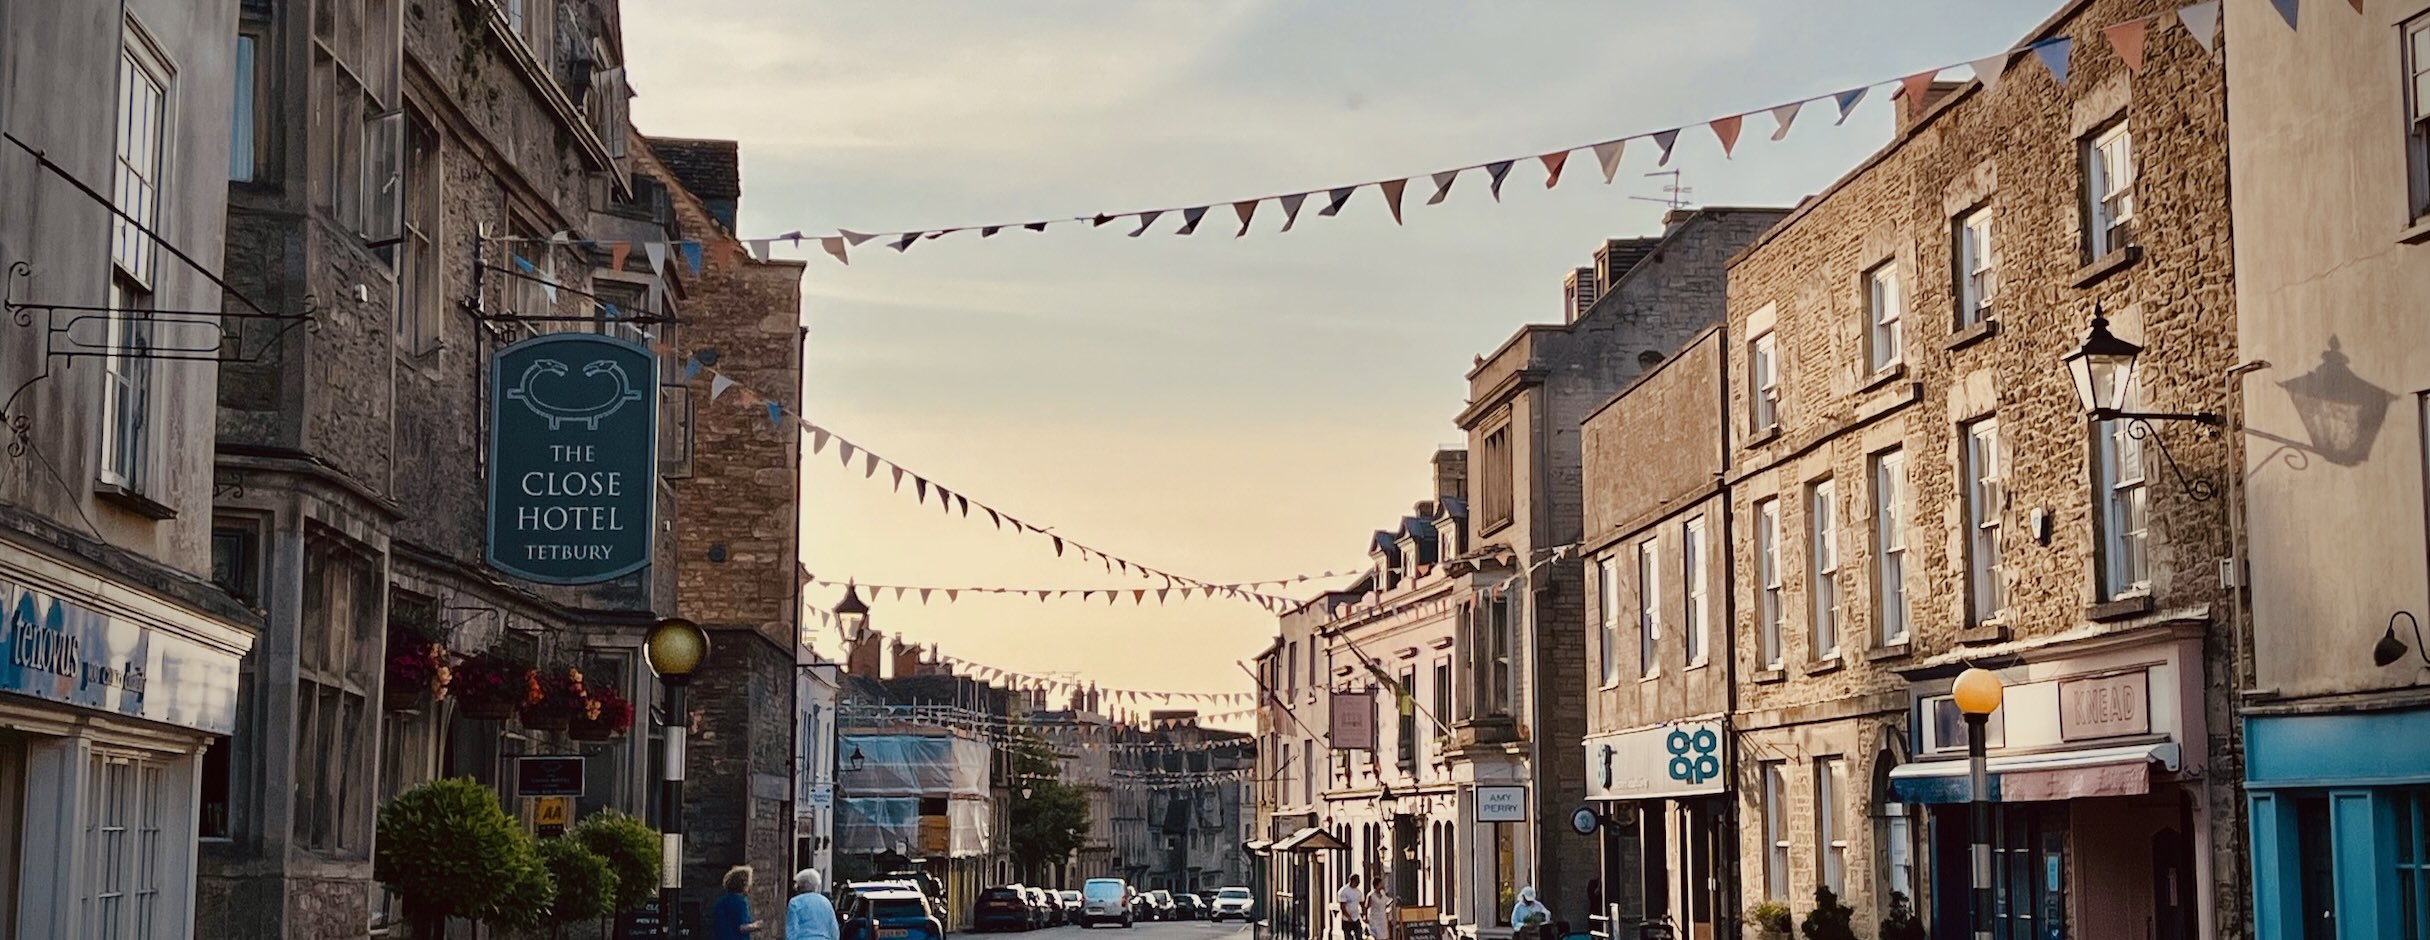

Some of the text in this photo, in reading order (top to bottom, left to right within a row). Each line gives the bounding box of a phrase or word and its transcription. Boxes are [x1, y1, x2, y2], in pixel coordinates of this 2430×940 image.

[550, 444, 596, 463] THE
[521, 471, 622, 497] CLOSE
[517, 505, 624, 531] HOTEL
[525, 544, 614, 561] TETBURY
[14, 611, 80, 679] tenovus
[2074, 685, 2135, 725] KNEAD
[1490, 793, 1511, 802] AMY
[542, 805, 563, 821] AA
[1483, 803, 1518, 813] PERRY
